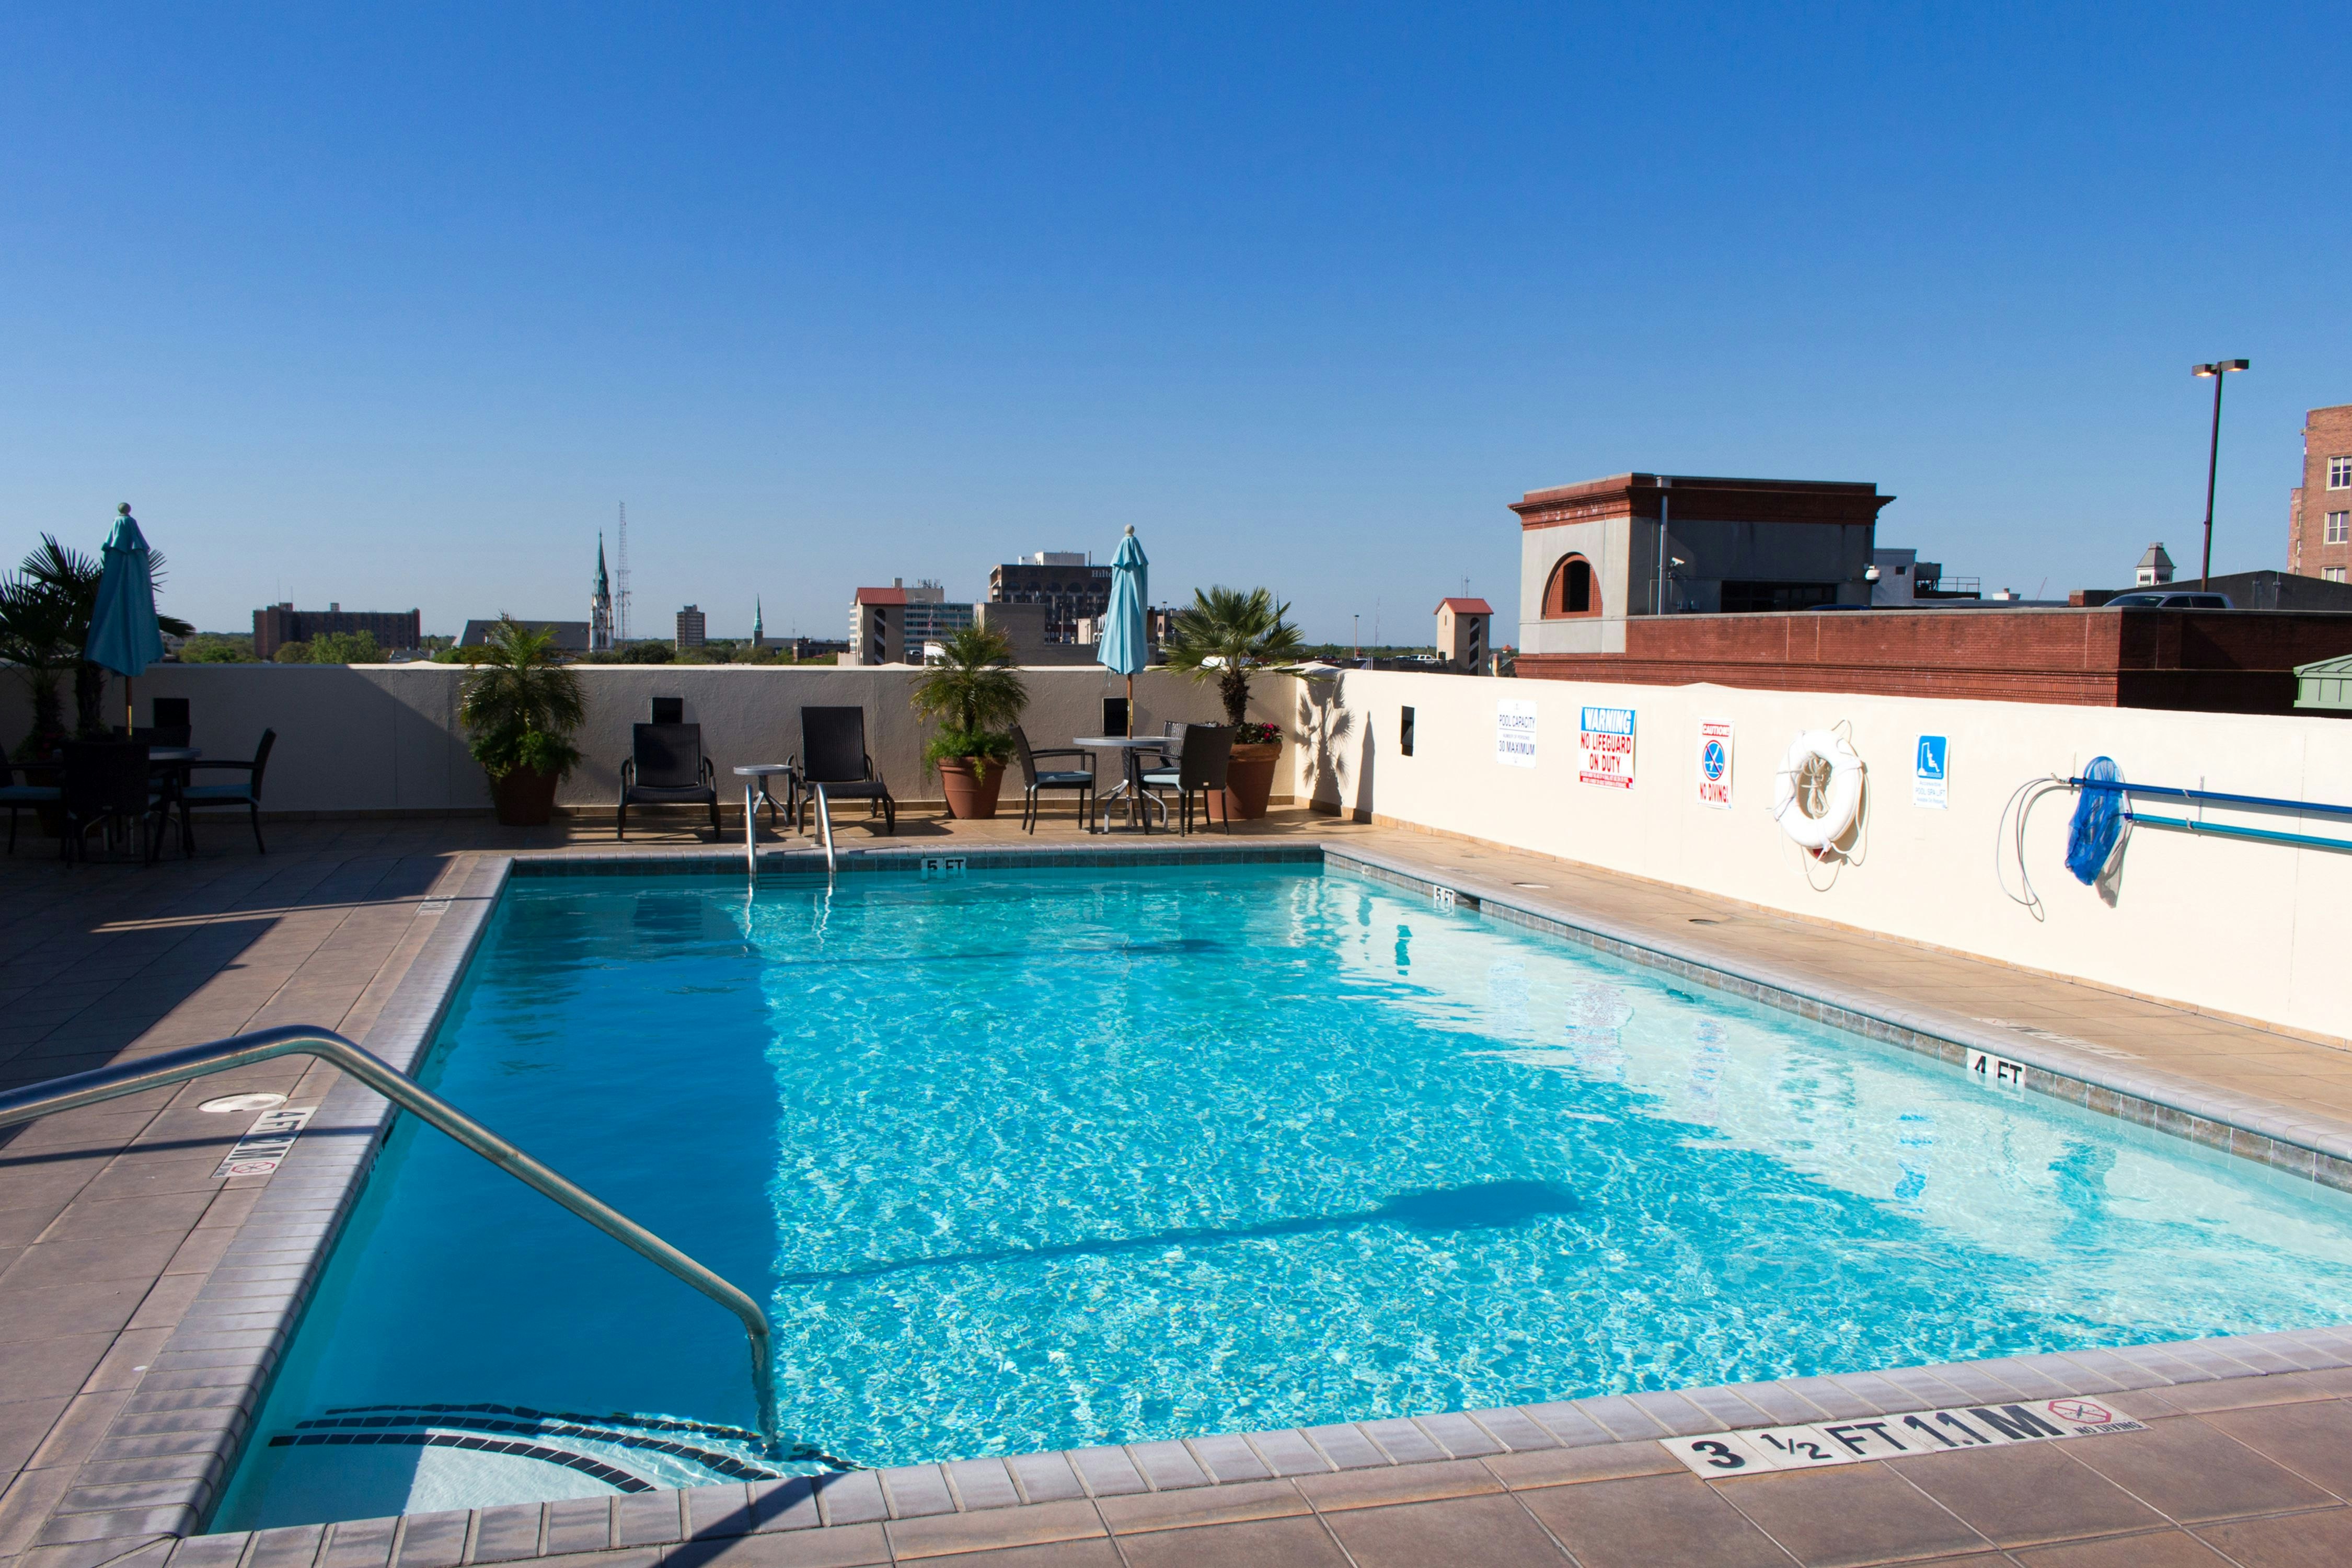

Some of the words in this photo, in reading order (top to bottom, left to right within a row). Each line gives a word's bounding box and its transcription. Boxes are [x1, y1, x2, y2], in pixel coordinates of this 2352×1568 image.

[1091, 569, 1113, 578] Hilto
[1499, 714, 1511, 727] POOL
[1512, 716, 1536, 729] CAPACITY
[1584, 708, 1631, 734] WARNING
[1498, 740, 1505, 752] 30
[1506, 741, 1535, 755] MAXIMUM
[1581, 732, 1589, 750] NO
[1593, 733, 1631, 754] LIFEGUARD
[1589, 753, 1598, 771] ON
[1602, 754, 1620, 773] DUTY
[1700, 781, 1707, 800] NO
[927, 860, 938, 870] 5
[946, 859, 964, 870] FT
[1445, 890, 1453, 903] FT
[1997, 1060, 2022, 1084] FT
[255, 1120, 301, 1132] FT
[228, 1146, 288, 1160] M
[2073, 1426, 2097, 1435] NO
[2095, 1421, 2143, 1432] DIVING
[1691, 1440, 1746, 1468] 3
[1823, 1422, 1909, 1455] FT
[1903, 1412, 1992, 1447] 1.1
[1965, 1405, 2067, 1440] M
